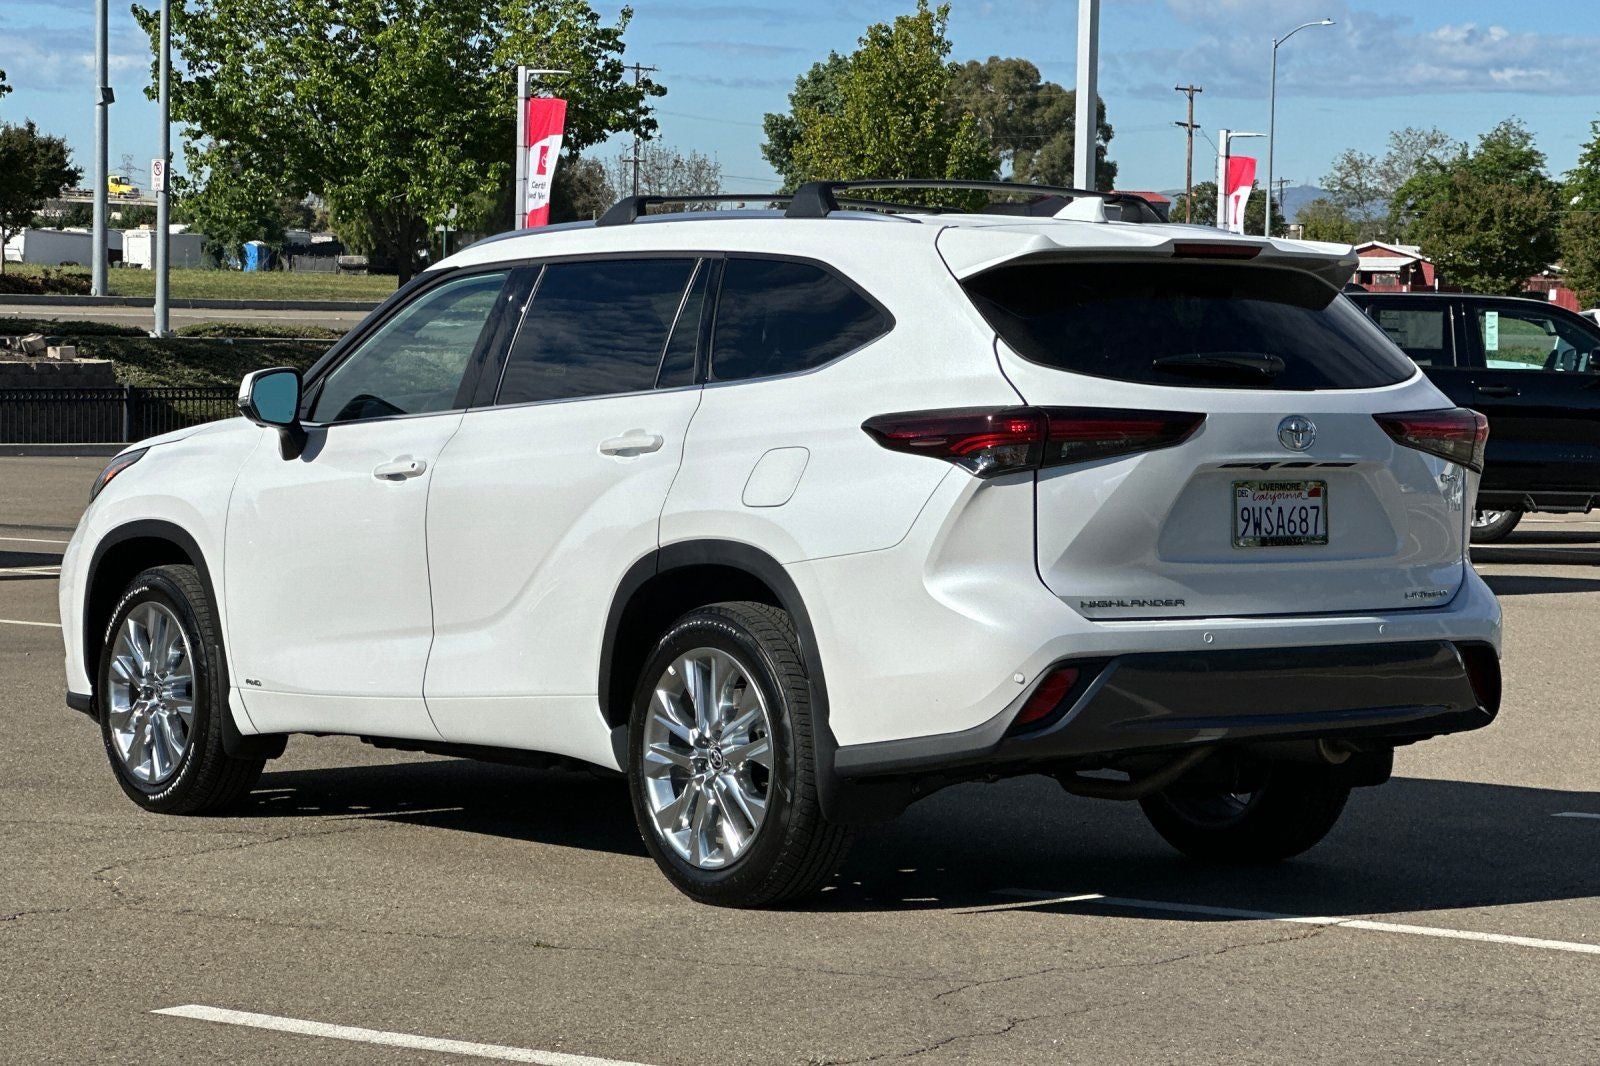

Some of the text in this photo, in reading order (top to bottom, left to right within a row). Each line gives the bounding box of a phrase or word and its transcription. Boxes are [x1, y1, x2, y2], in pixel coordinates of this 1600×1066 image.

[1259, 482, 1301, 491] LIVERMORE
[1237, 489, 1249, 498] DEC
[1252, 491, 1308, 505] California
[1240, 505, 1320, 537] 9WSA687
[1080, 599, 1186, 608] HIGHLANDER
